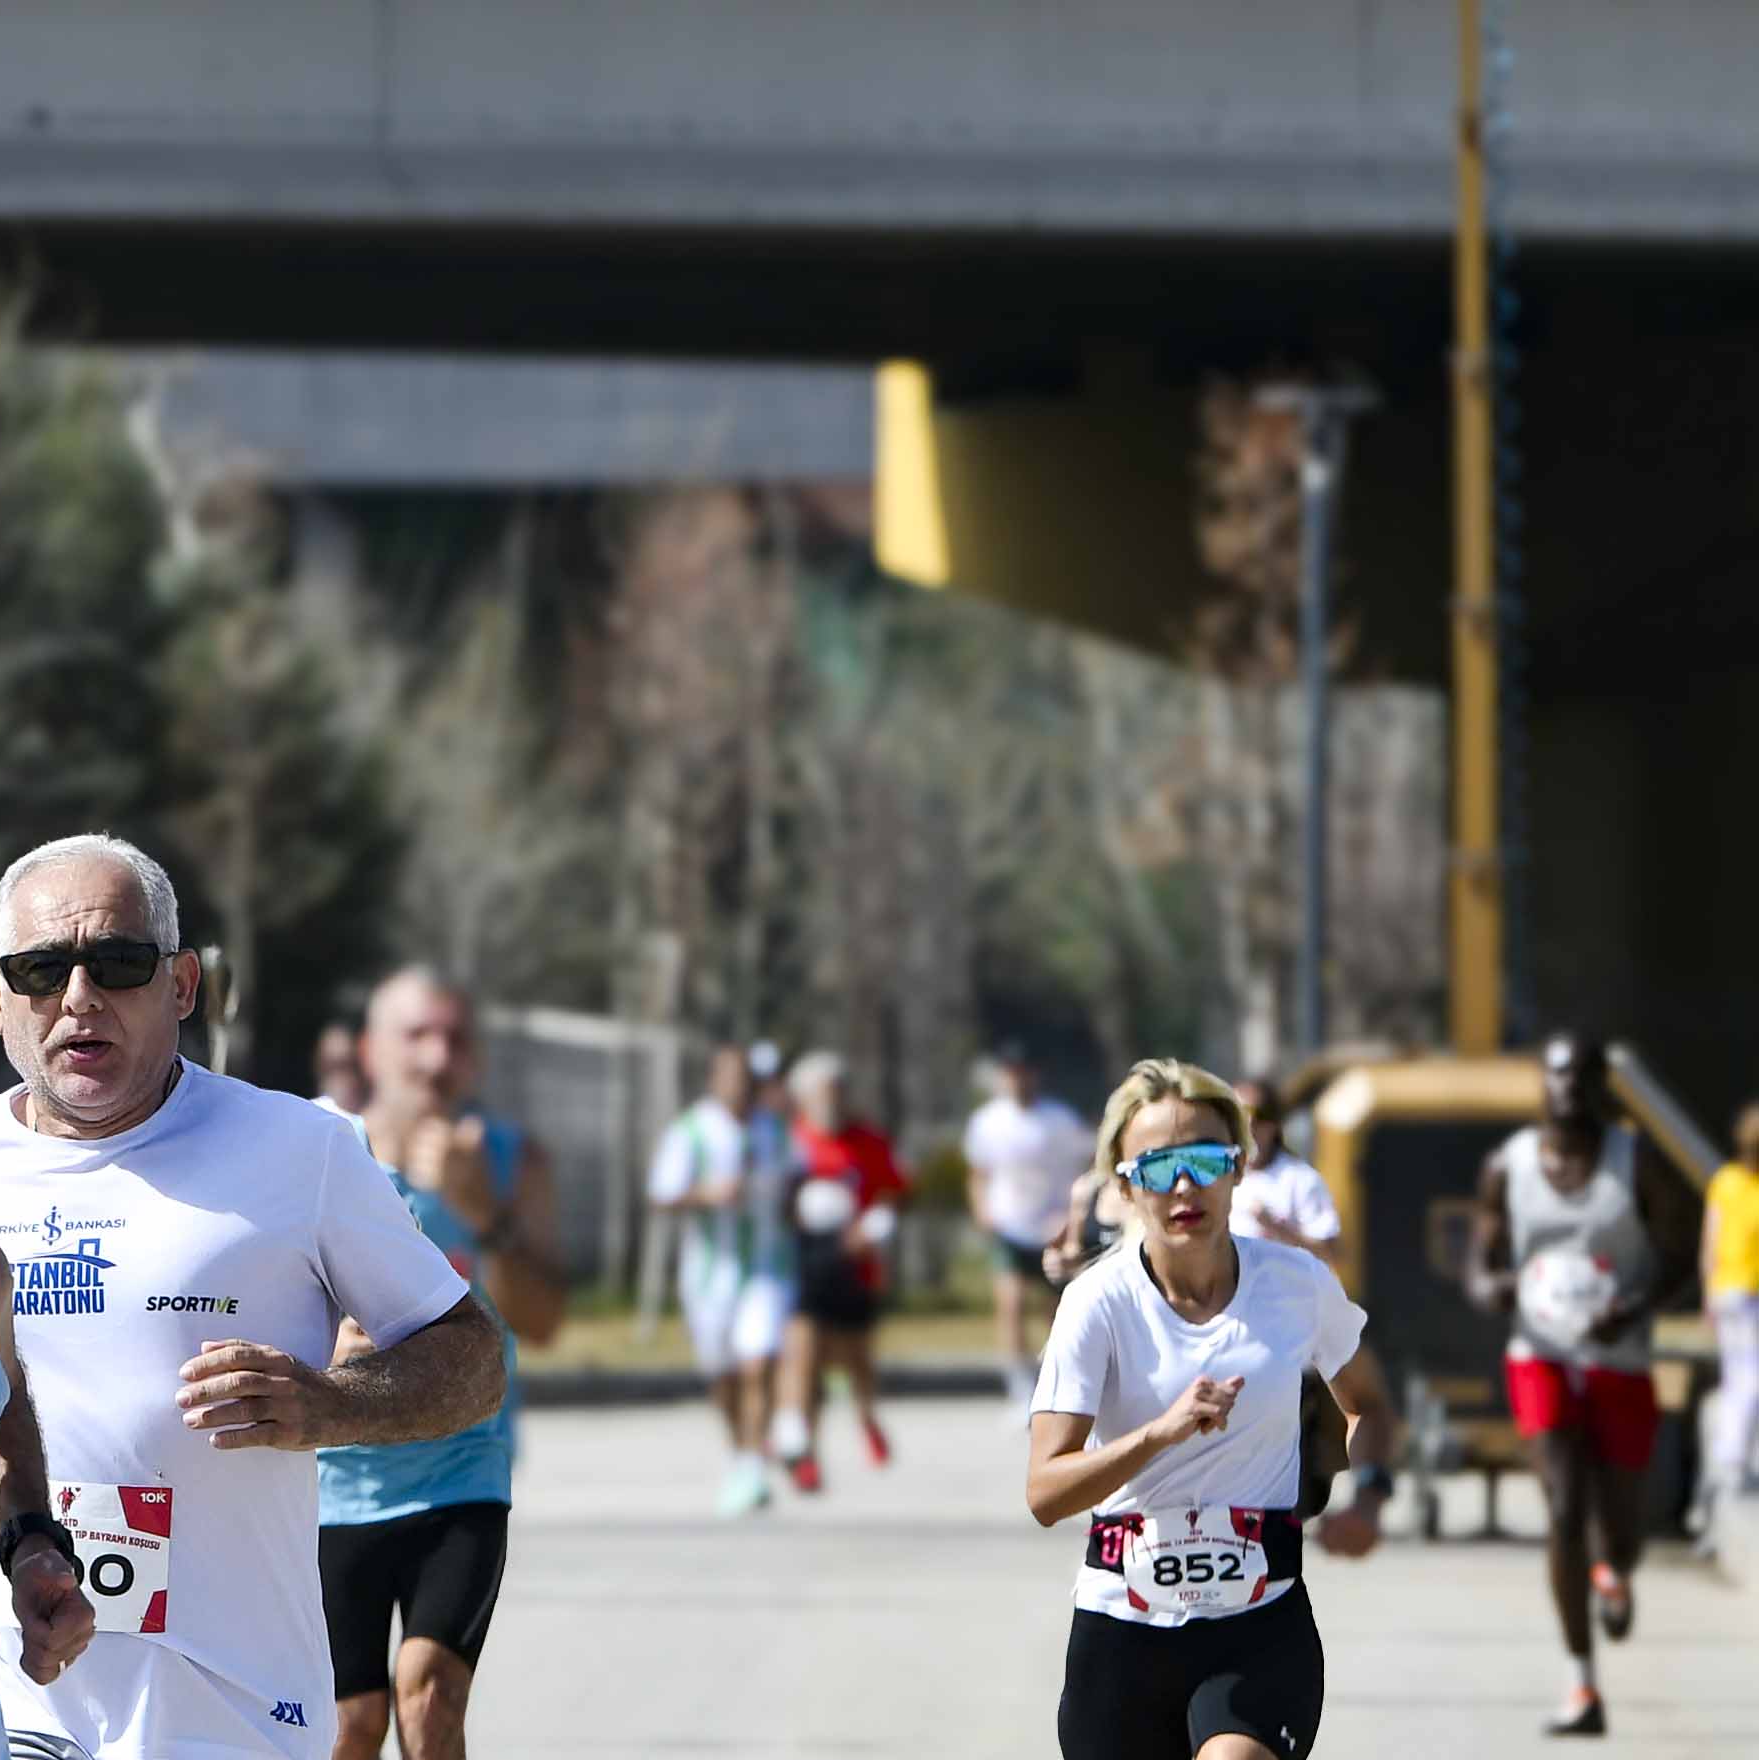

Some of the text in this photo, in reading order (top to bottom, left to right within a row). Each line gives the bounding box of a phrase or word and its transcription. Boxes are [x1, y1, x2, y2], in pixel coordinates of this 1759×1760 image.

[65, 1218, 126, 1231] BANKASI
[11, 1261, 104, 1289] TANBUL
[14, 1288, 105, 1315] ARATONU
[146, 1295, 239, 1314] SPORTIVE
[140, 1492, 167, 1504] 10K
[75, 1530, 161, 1551] TIP BAYRAMI KOŞUSU
[1153, 1552, 1245, 1587] 852
